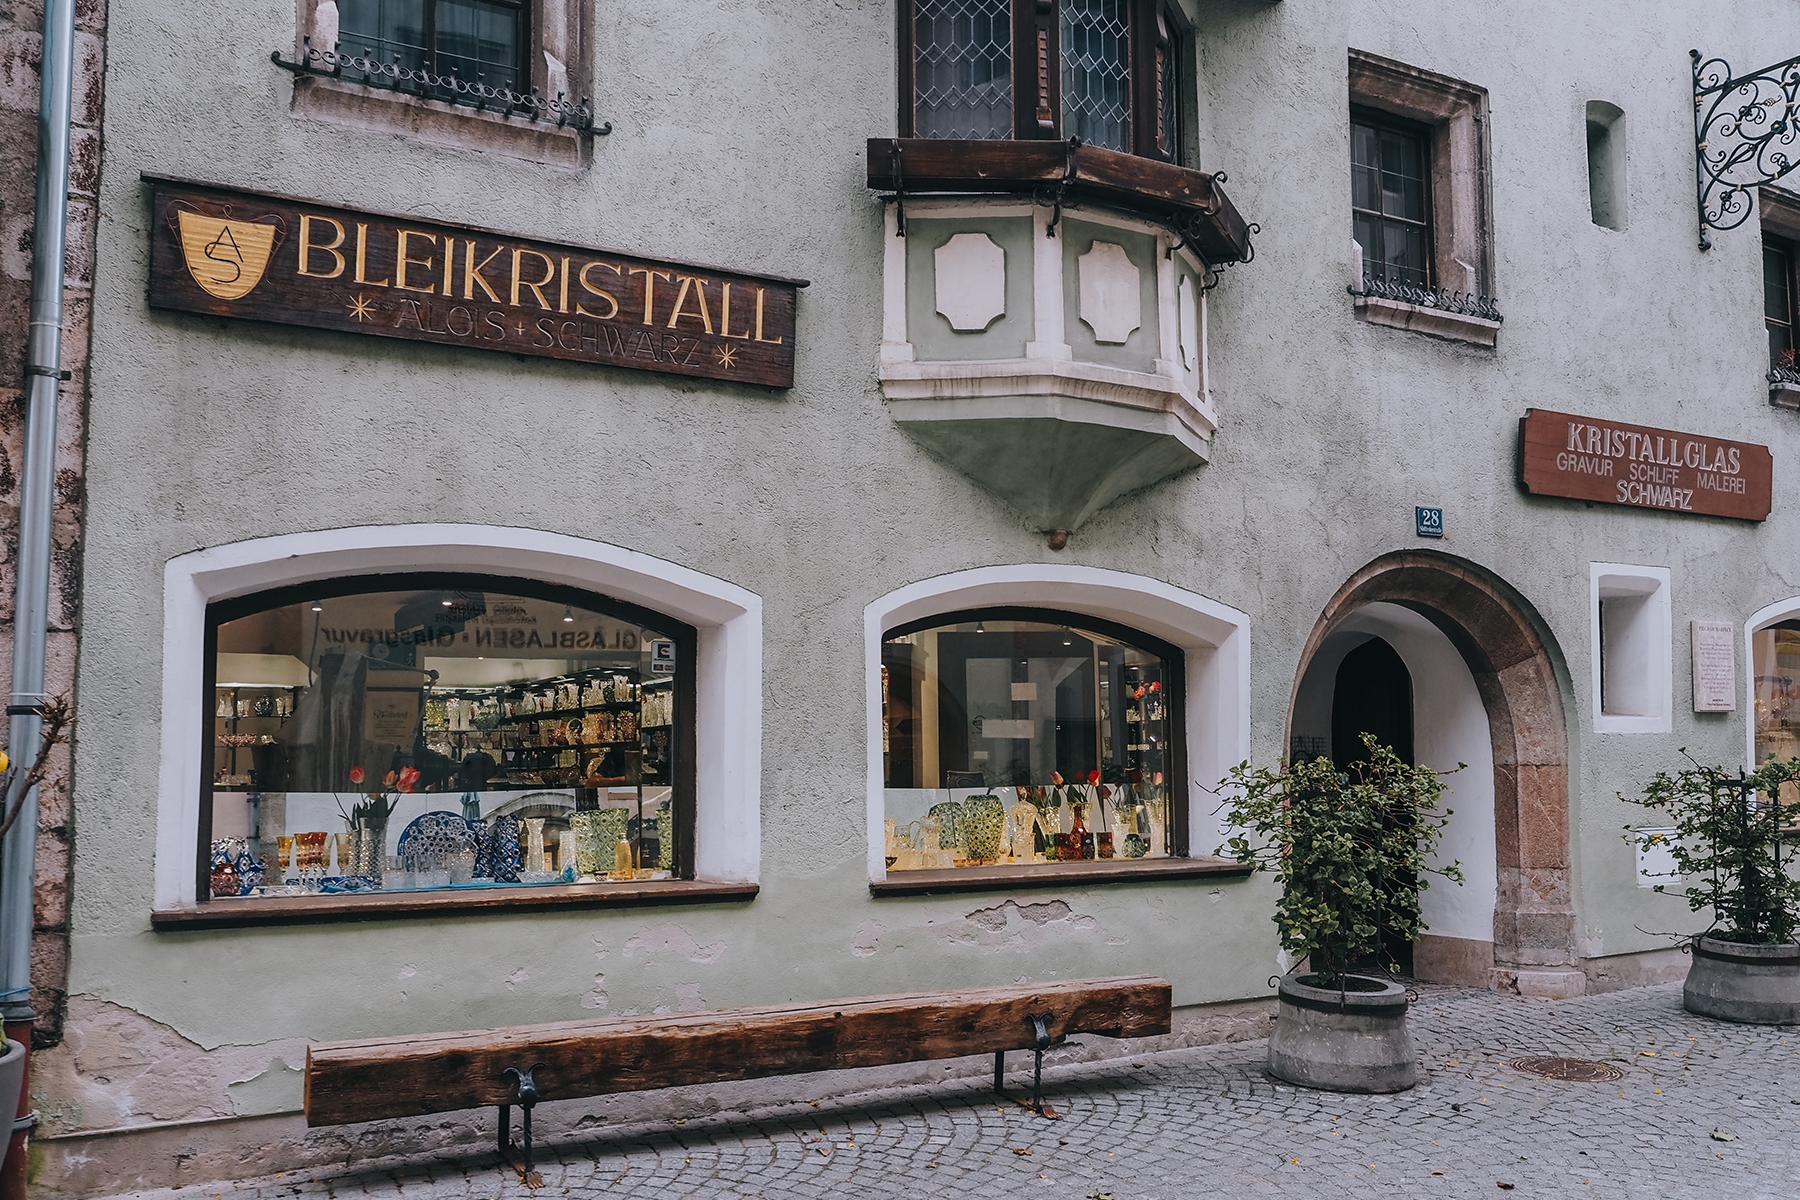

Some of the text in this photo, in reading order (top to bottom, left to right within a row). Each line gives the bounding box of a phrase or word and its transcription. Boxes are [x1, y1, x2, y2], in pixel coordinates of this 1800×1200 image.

[297, 212, 783, 345] BLEIKRISTALL
[394, 297, 701, 368] ALOIS SCHWARZ
[1567, 422, 1741, 475] KRISTALLGLAS
[1556, 452, 1746, 495] GRAVUR SCHLIFF MALEREI
[1616, 479, 1694, 511] SCHWARZ
[1422, 509, 1440, 527] 28
